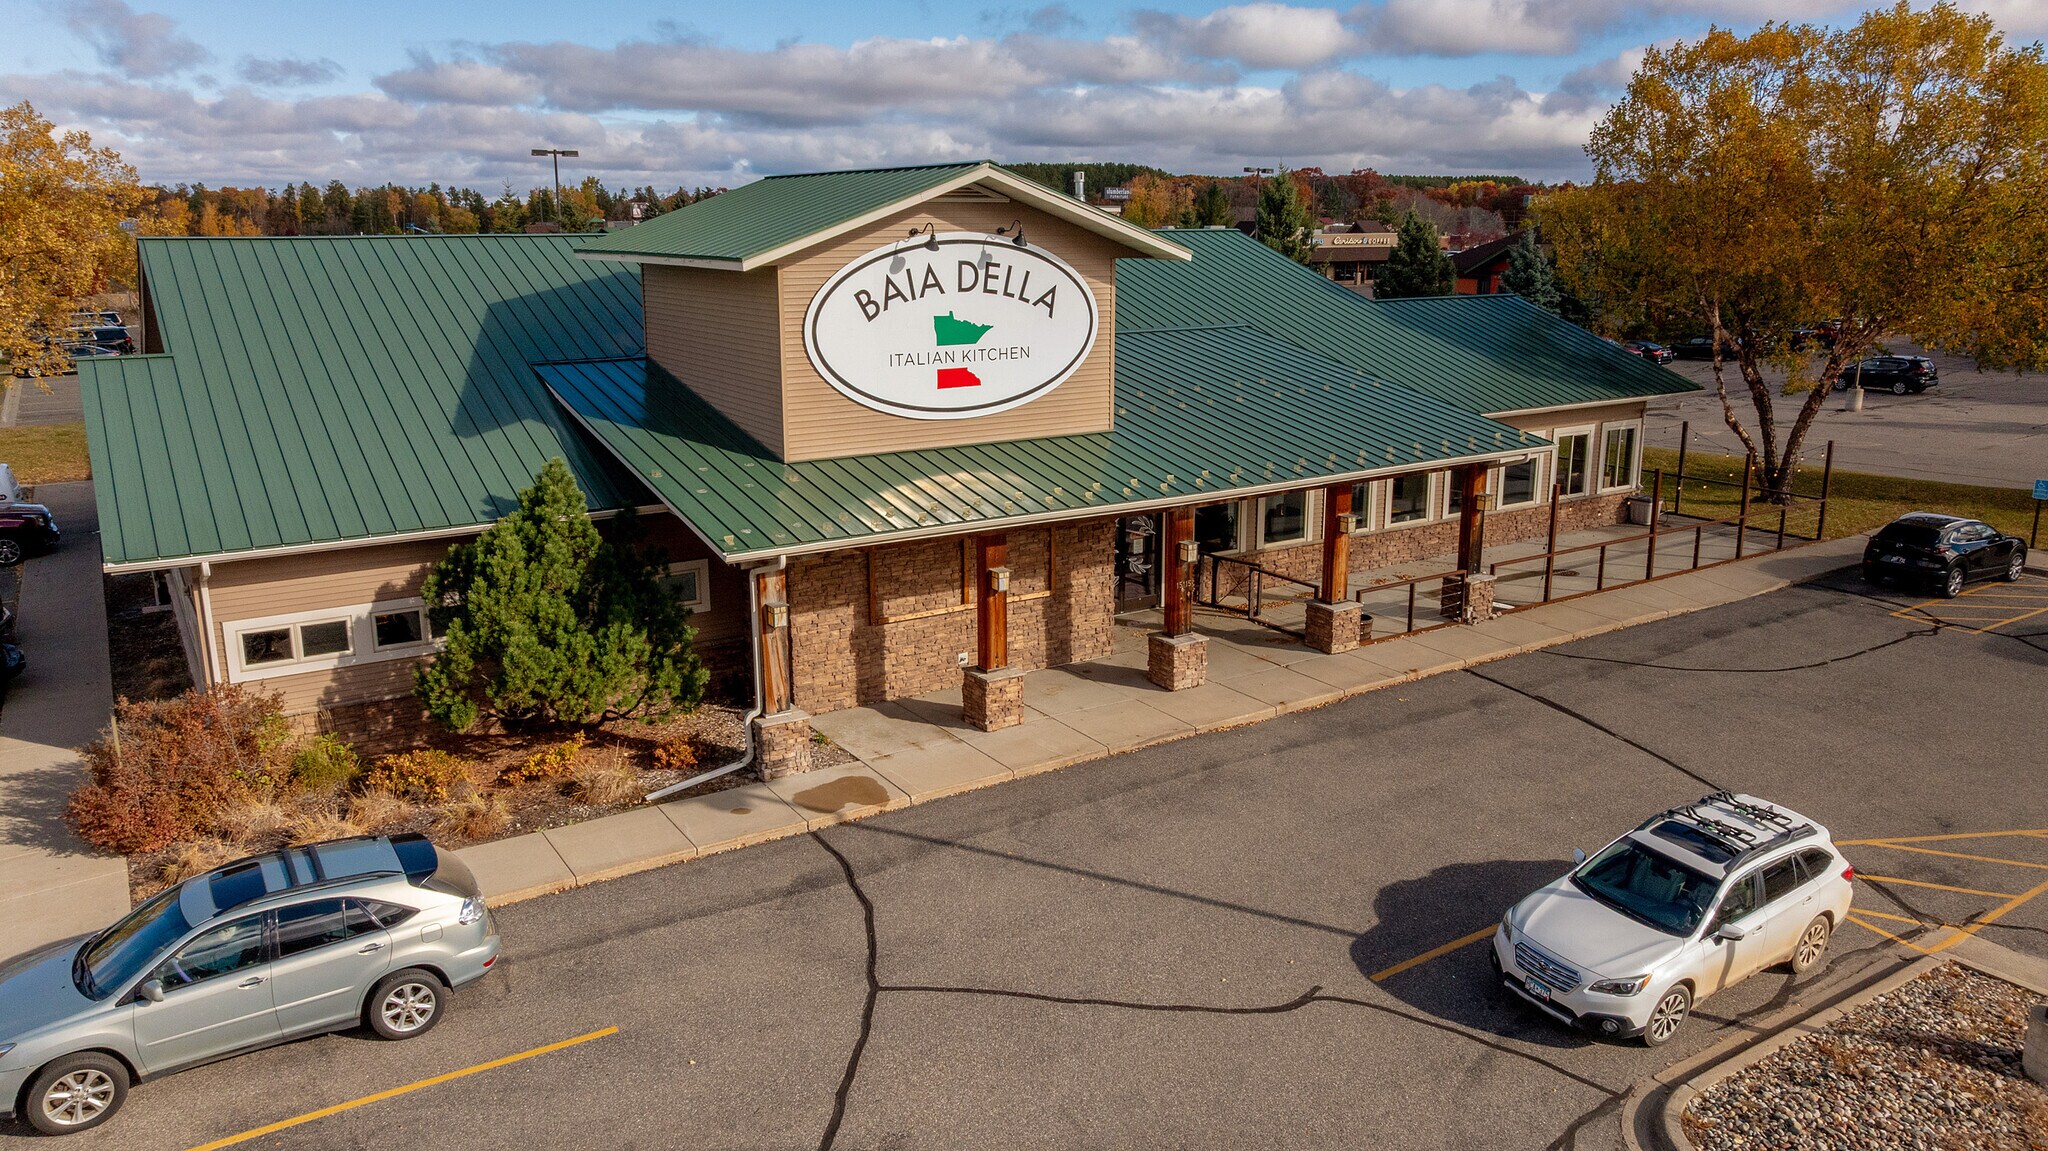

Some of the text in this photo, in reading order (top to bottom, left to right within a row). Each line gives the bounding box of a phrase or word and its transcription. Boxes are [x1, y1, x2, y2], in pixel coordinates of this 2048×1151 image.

[853, 260, 1057, 323] BAIA DELLA
[889, 346, 1031, 367] ITALIAN KITCHEN
